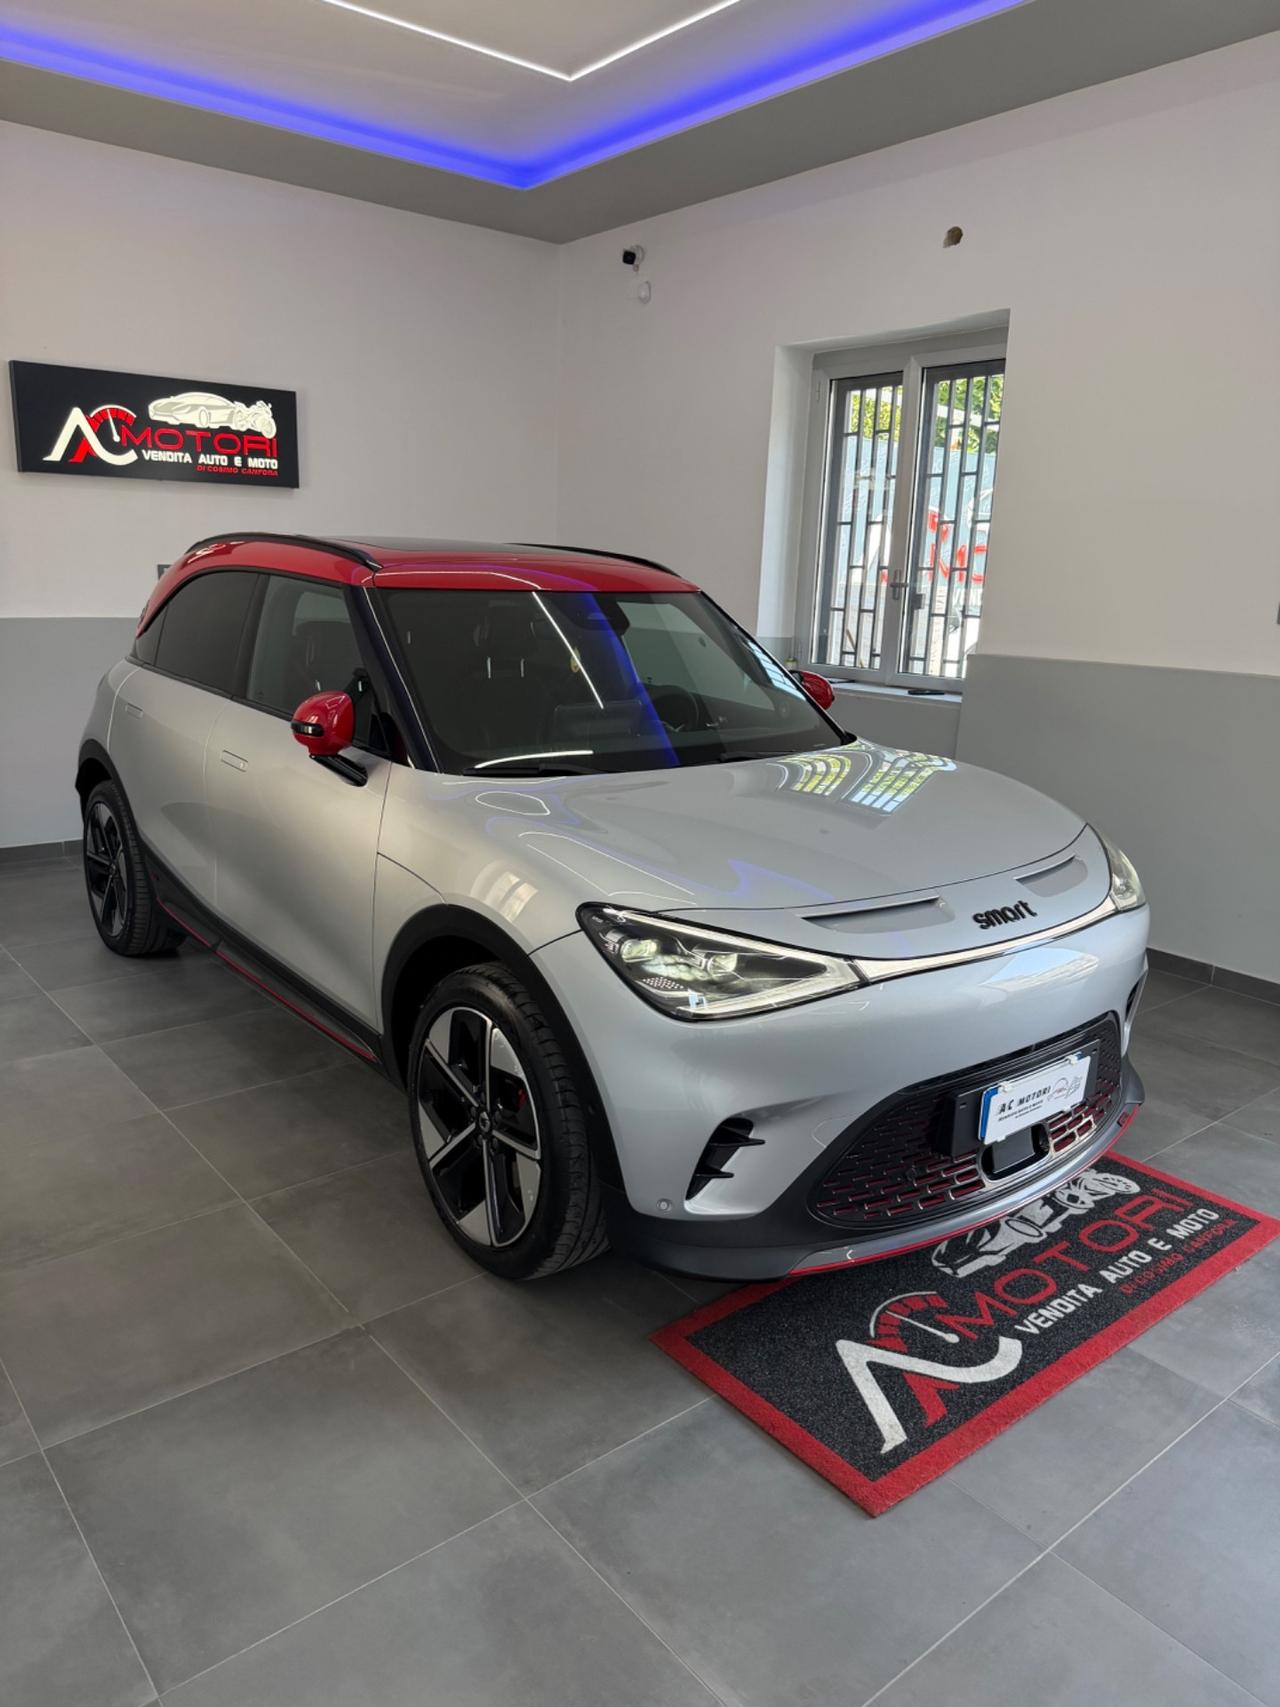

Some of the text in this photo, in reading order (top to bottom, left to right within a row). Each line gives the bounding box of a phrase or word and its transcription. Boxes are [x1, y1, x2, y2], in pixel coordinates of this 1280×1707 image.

[121, 424, 278, 457] MOTORI
[142, 449, 278, 469] VENDITA AUTO E MOTO
[972, 900, 1038, 929] smart
[998, 1099, 1015, 1114] AC
[1017, 1086, 1052, 1106] MOTORI
[934, 1187, 1194, 1341] MOTORI
[1015, 1208, 1220, 1335] VENDITA AUTO E MOTO
